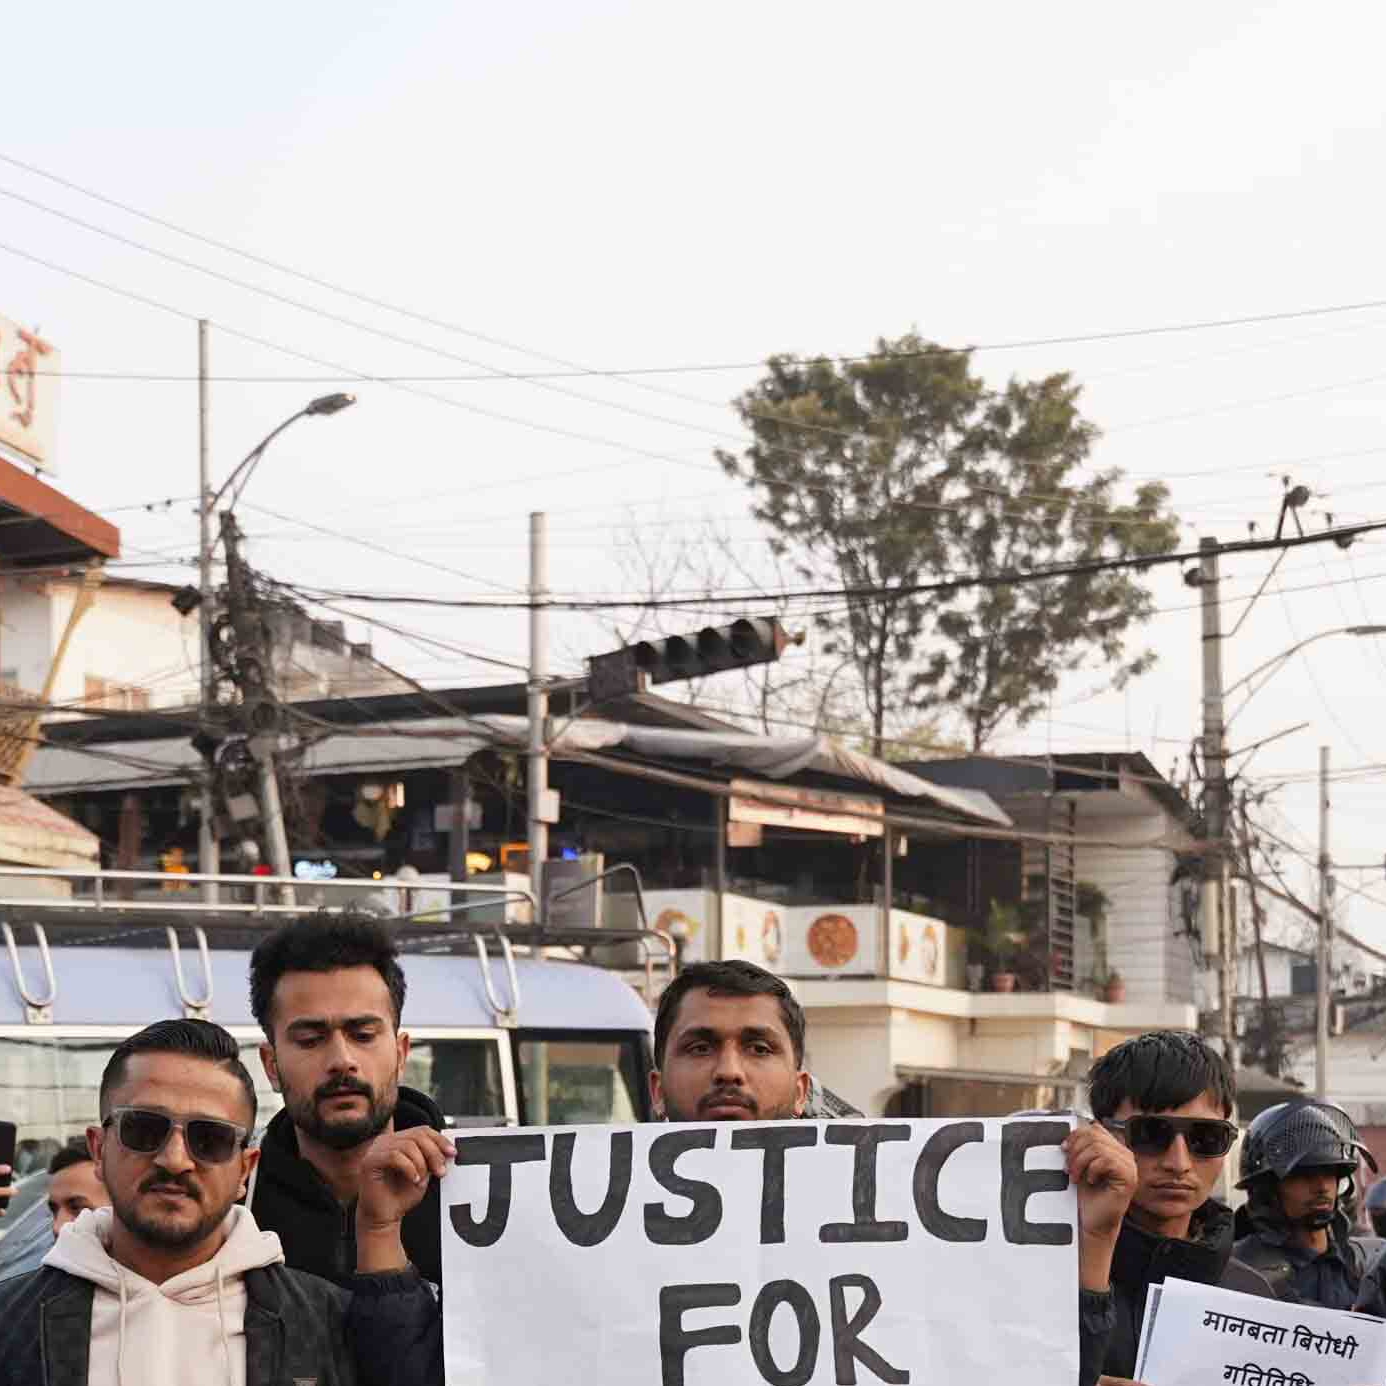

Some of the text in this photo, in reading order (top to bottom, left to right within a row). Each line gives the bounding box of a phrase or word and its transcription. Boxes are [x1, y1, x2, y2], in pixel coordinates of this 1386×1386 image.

[449, 1119, 1075, 1248] JUSTICE
[1203, 1310, 1359, 1360] मानबता बिरोधी
